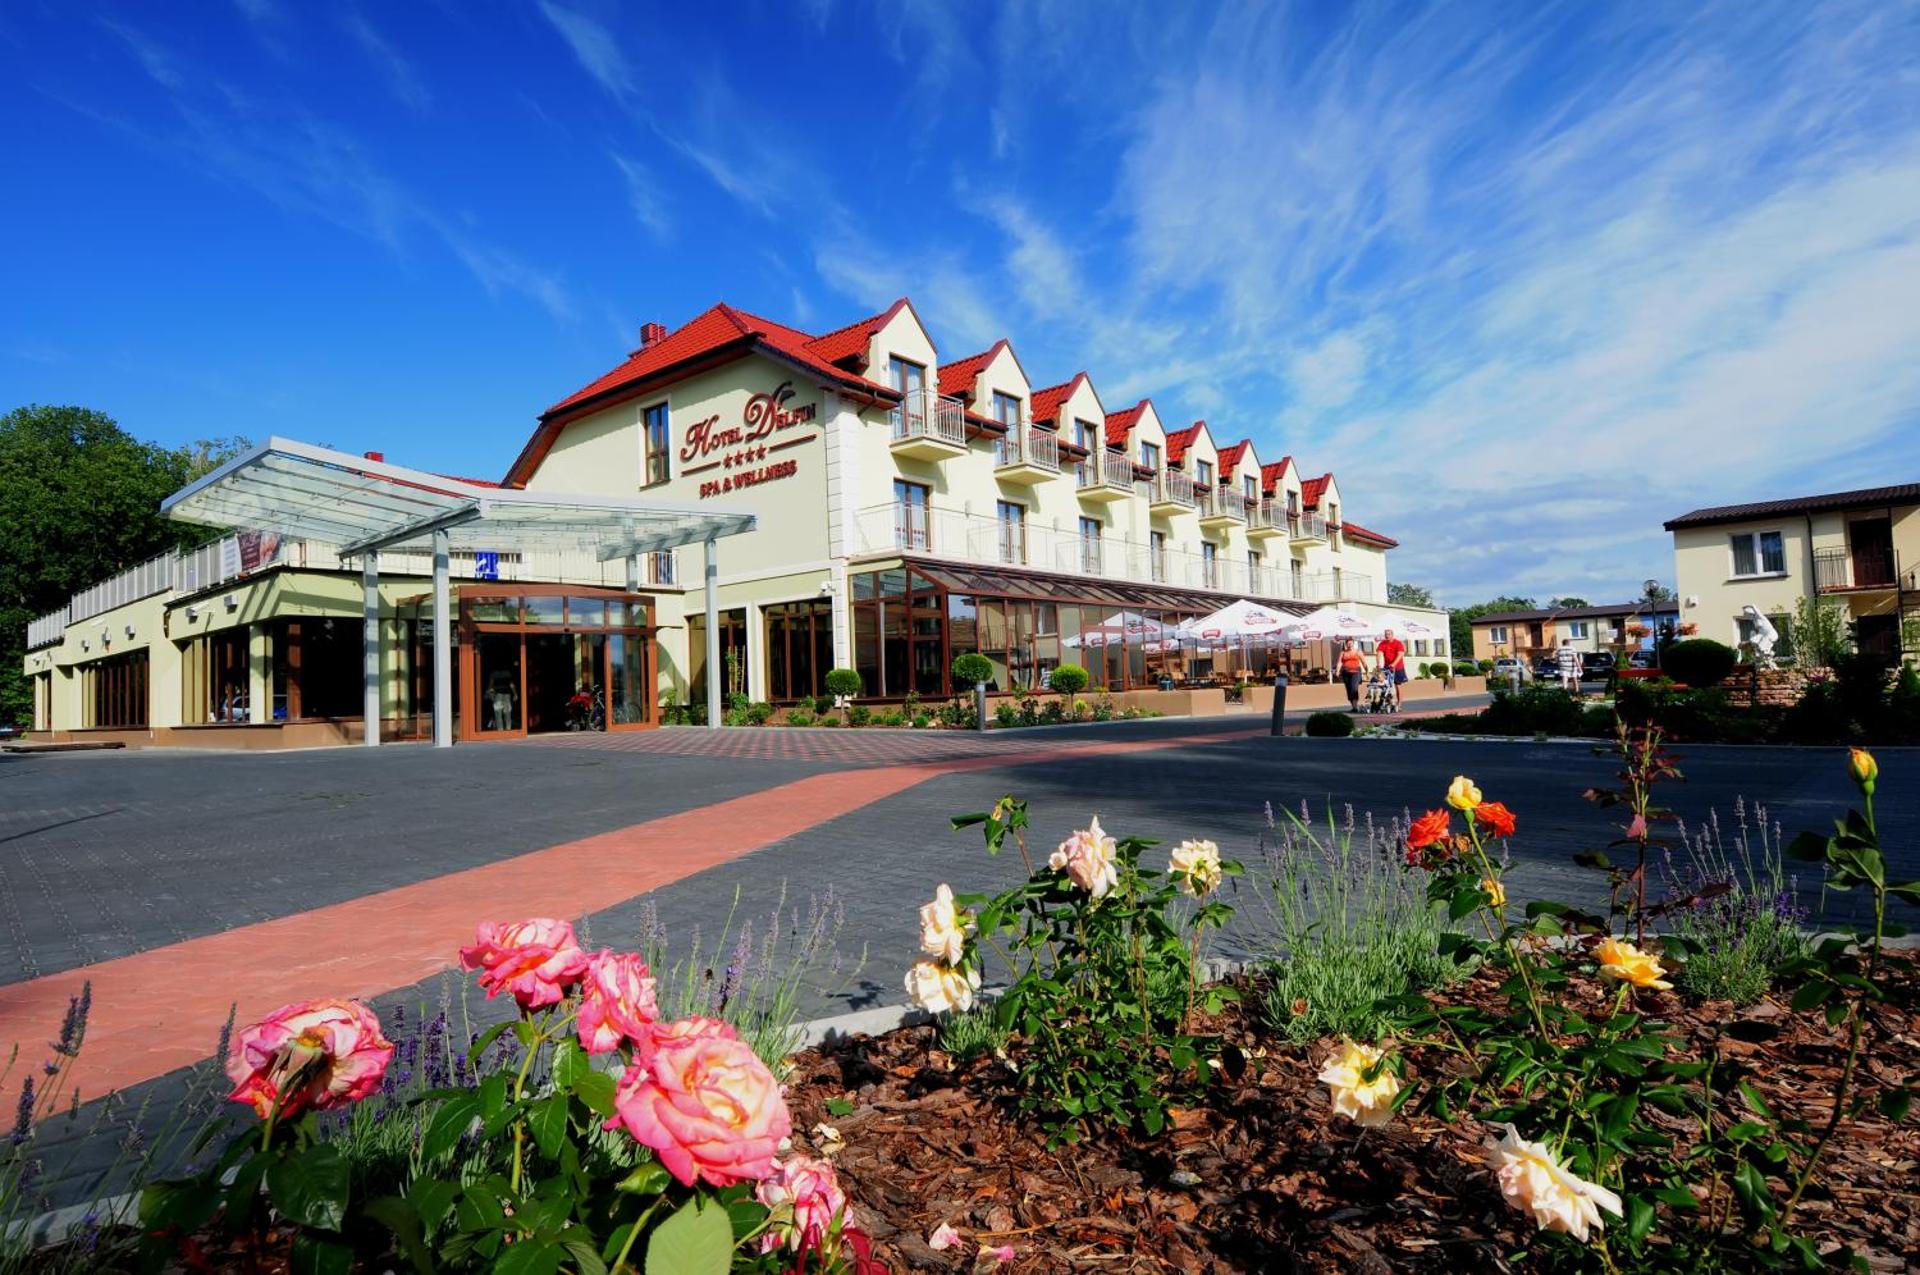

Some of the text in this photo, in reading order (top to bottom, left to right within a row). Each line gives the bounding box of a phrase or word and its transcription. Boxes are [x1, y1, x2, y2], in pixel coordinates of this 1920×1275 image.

[700, 459, 797, 498] SPA & WELLNESS
